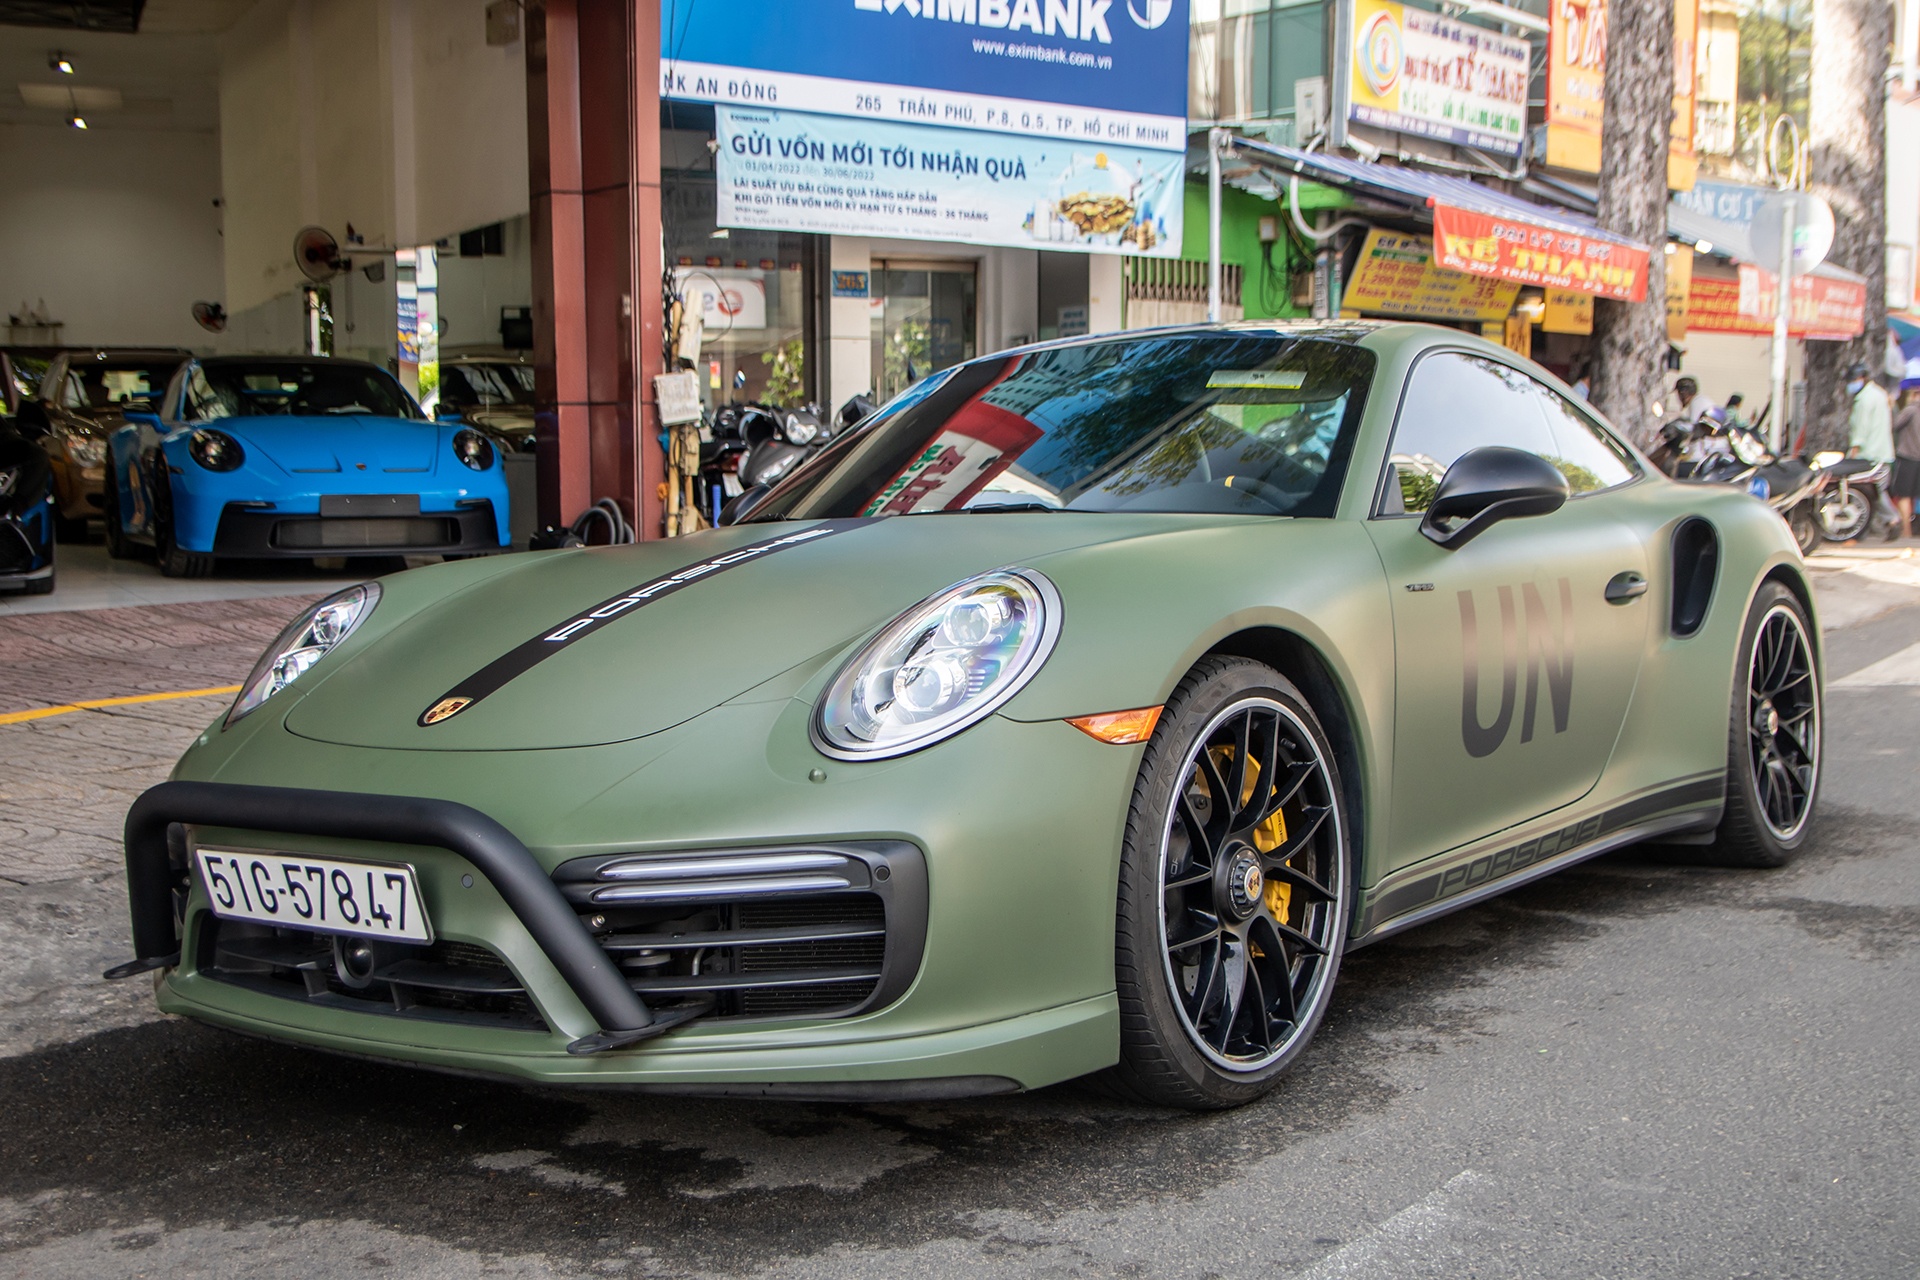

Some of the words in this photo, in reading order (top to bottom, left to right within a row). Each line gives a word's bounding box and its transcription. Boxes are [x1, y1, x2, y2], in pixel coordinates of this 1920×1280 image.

[854, 0, 1112, 44] XIMBANK
[972, 38, 1112, 70] www.eximbank.com.vn
[696, 78, 718, 96] AN
[728, 80, 778, 101] ĐÔNG
[855, 95, 882, 112] 265
[899, 97, 937, 116] TRẦN
[1057, 115, 1076, 133] TP.
[1084, 116, 1101, 136] HỒ
[1108, 120, 1130, 140] CHÍ
[1136, 126, 1170, 144] MINH
[731, 129, 772, 156] GỬI
[778, 133, 825, 161] VỐN
[832, 140, 873, 166] MỚI
[880, 144, 914, 170] TỚI
[922, 149, 978, 180] NHẬN
[985, 156, 1027, 183] QUÀ
[745, 160, 801, 176] 01/04/2022
[823, 167, 875, 181] 30/06/2022
[734, 193, 752, 204] KHI
[544, 529, 834, 642] PORSCHE
[1457, 577, 1575, 758] UN
[1439, 819, 1600, 896] PORSCHE
[204, 855, 407, 931] 51G-578.47
